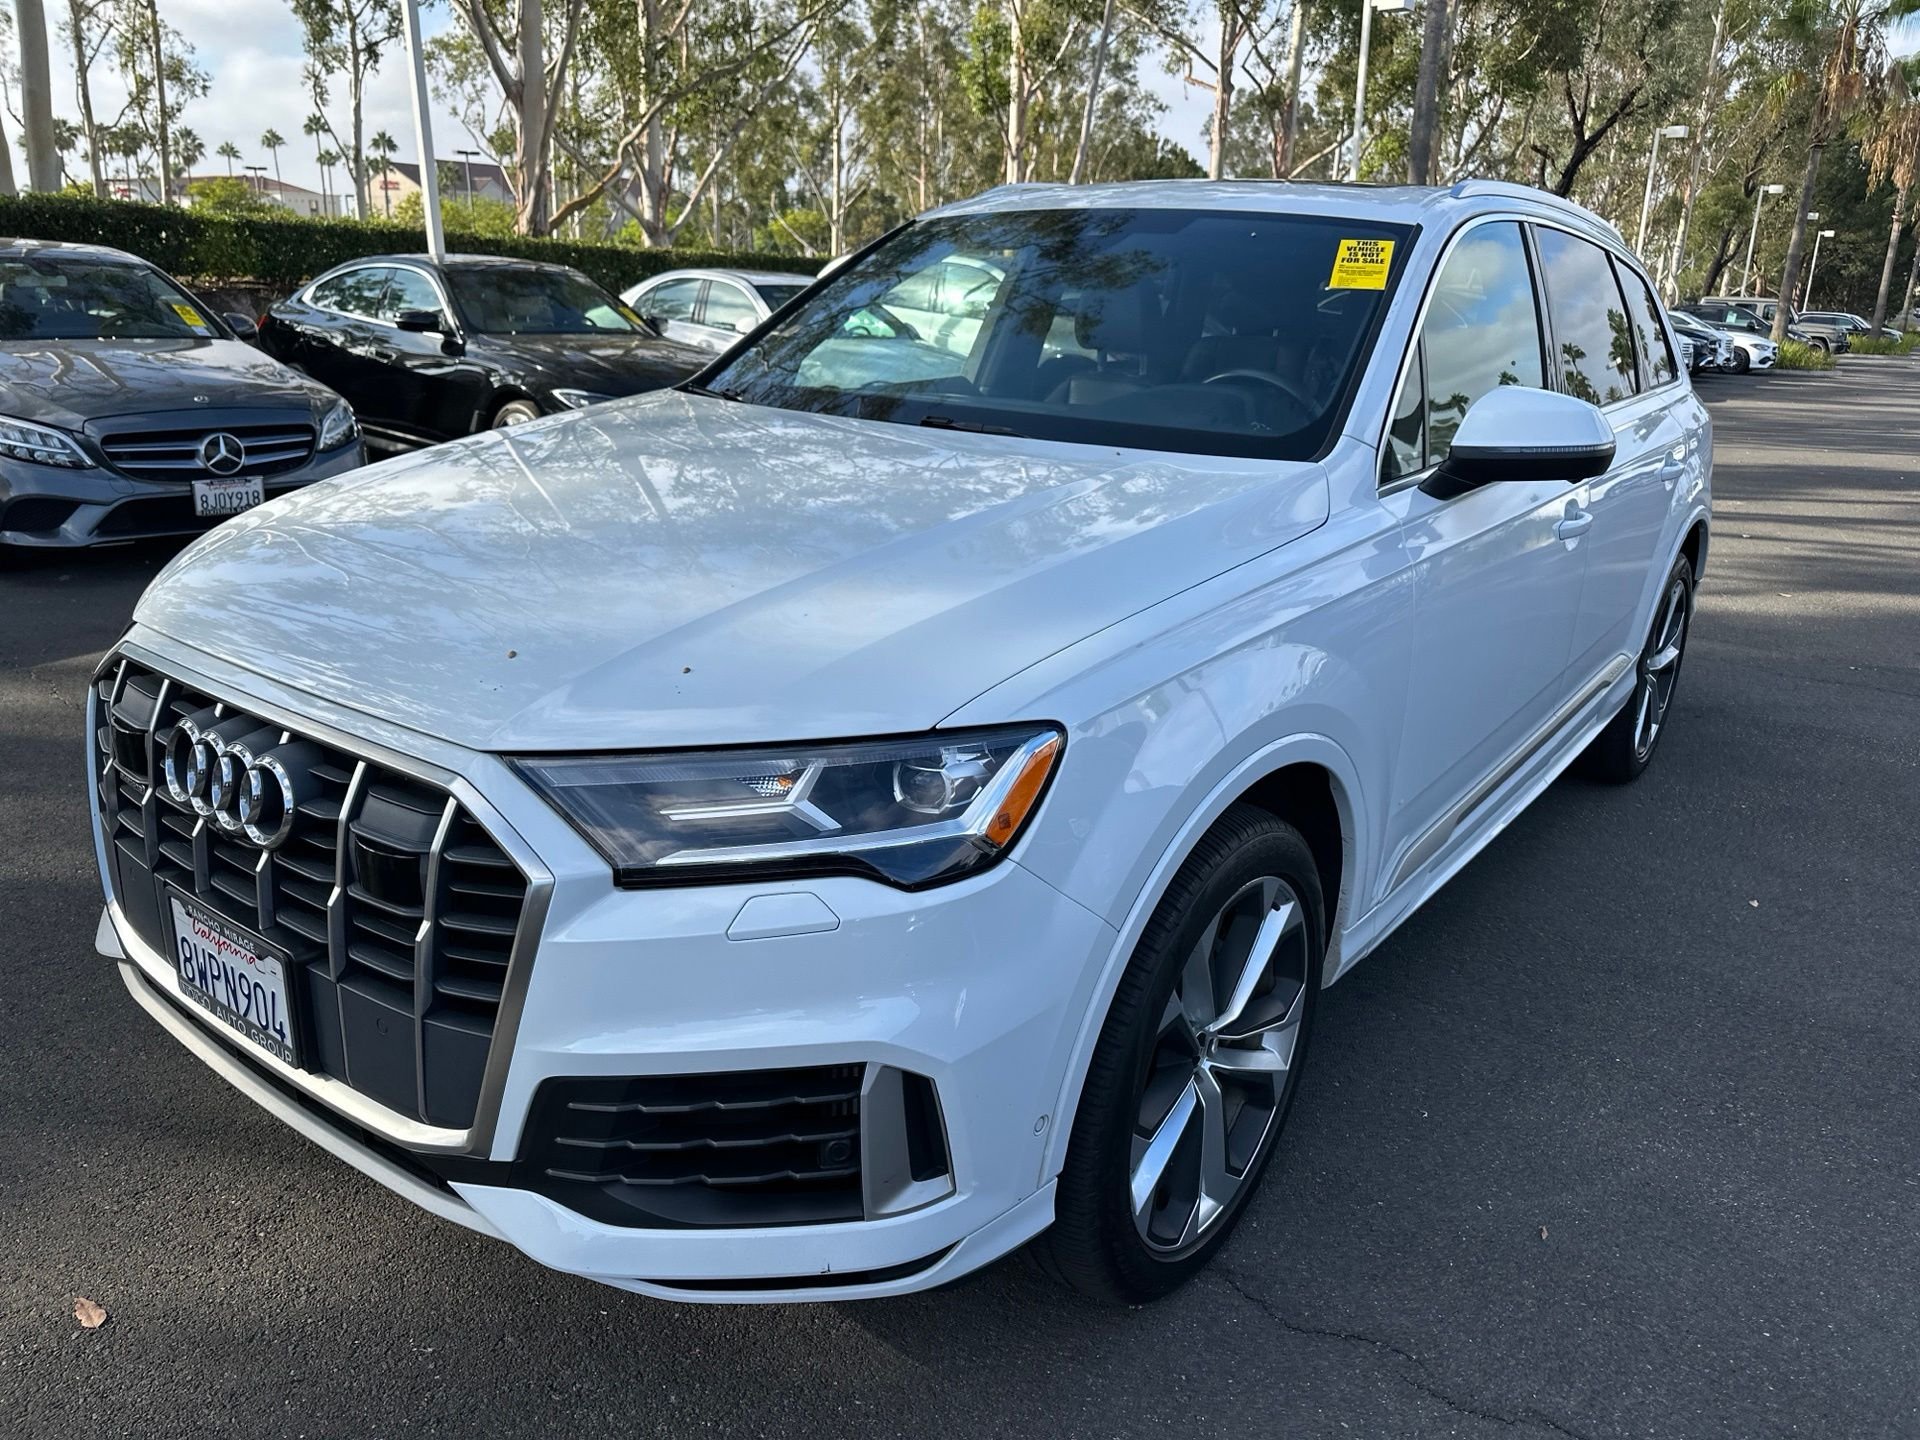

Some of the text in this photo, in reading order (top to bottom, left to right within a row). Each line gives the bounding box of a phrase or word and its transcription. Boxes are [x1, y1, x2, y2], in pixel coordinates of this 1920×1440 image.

[186, 905, 256, 953] RANCHO MIRAGE
[192, 918, 261, 969] California
[180, 935, 287, 1044] 8WPN904
[216, 1006, 248, 1034] AUTO
[251, 1029, 293, 1064] GROUP
